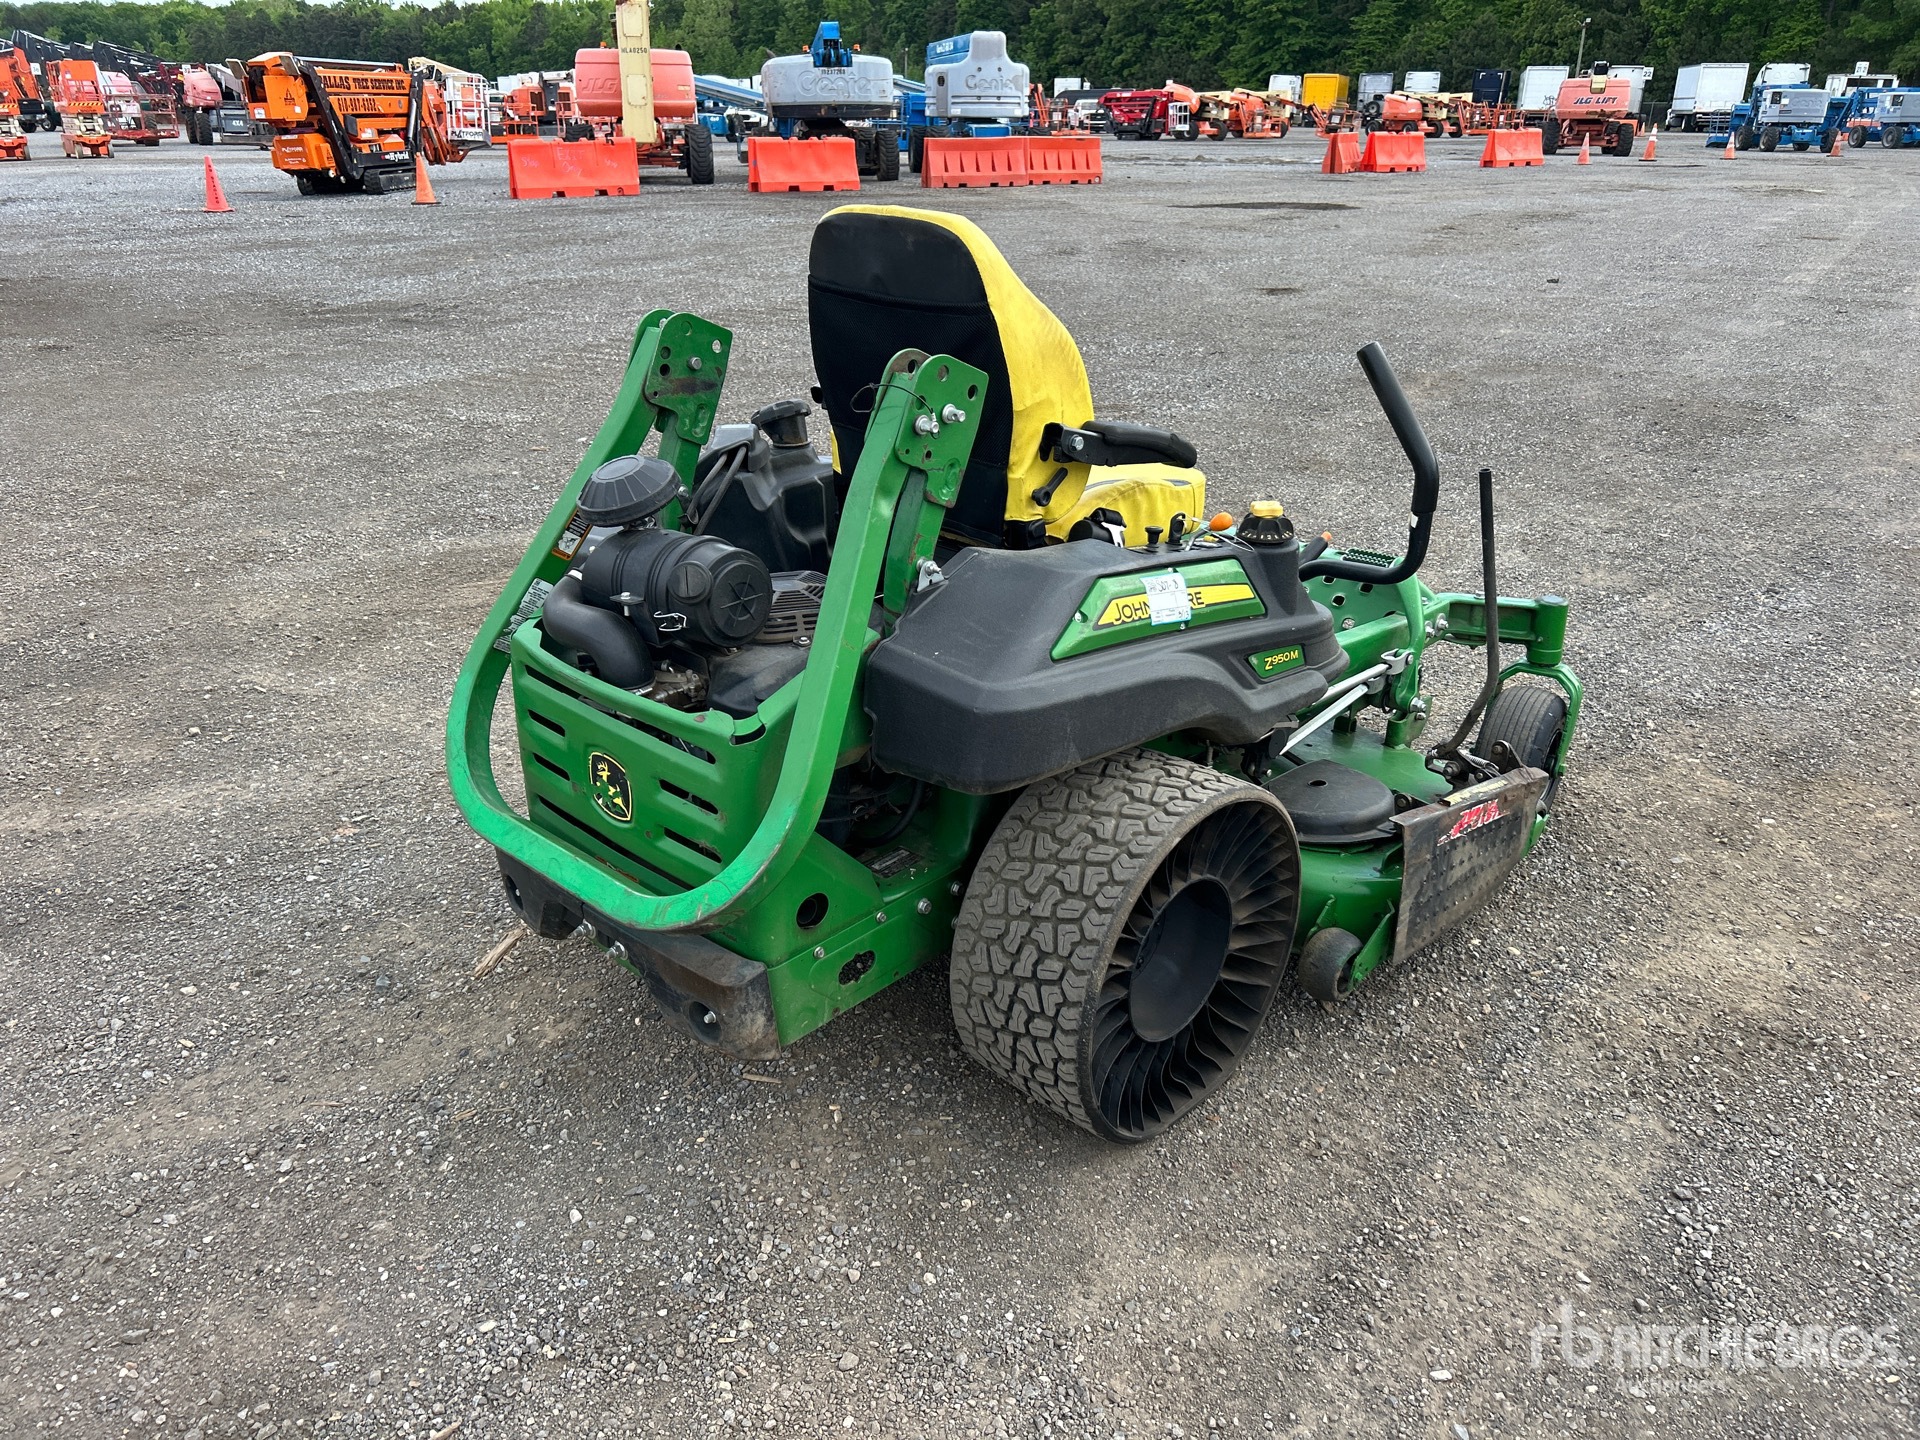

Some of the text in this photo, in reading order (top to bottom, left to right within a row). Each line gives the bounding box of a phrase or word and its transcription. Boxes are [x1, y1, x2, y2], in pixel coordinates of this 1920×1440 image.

[1643, 70, 1652, 78] 22
[320, 75, 407, 91] ALLAS TREE SERVICE INC.
[582, 77, 619, 94] JLG
[798, 70, 871, 97] Genie
[1573, 96, 1618, 105] JLG LIFT
[389, 151, 410, 162] Hybrid
[1114, 600, 1151, 622] JOHN
[1264, 650, 1299, 670] Z950M
